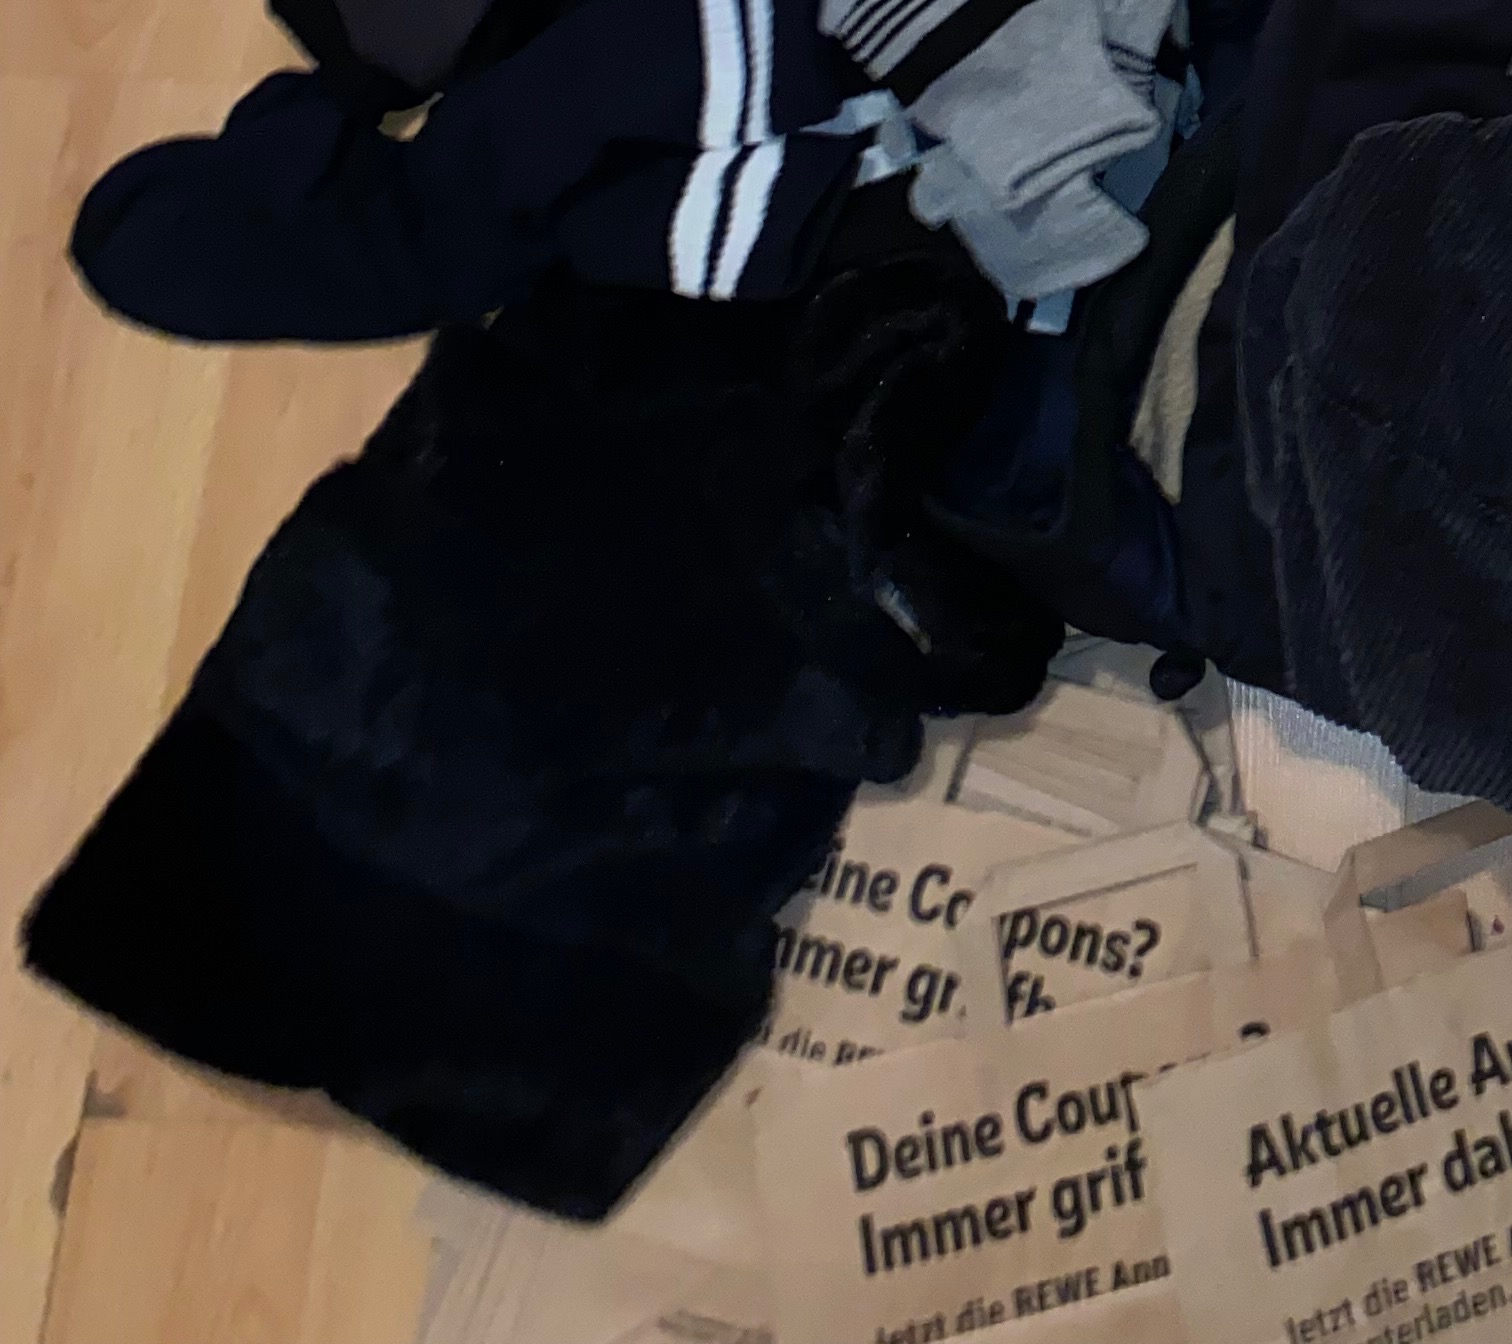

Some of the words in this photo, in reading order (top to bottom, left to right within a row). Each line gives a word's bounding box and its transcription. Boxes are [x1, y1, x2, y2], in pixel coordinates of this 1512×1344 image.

[775, 925, 901, 1000] mmer
[1000, 909, 1163, 979] pons?
[846, 1109, 1004, 1193] Deine
[1246, 1060, 1461, 1190] Aktuelle
[859, 1185, 1038, 1278] Immer
[1258, 1162, 1429, 1269] Immer
[1012, 1265, 1101, 1319] REWE
[1284, 1296, 1357, 1344] Jetzt
[1364, 1276, 1411, 1320] die
[1413, 1232, 1503, 1293] REWE
